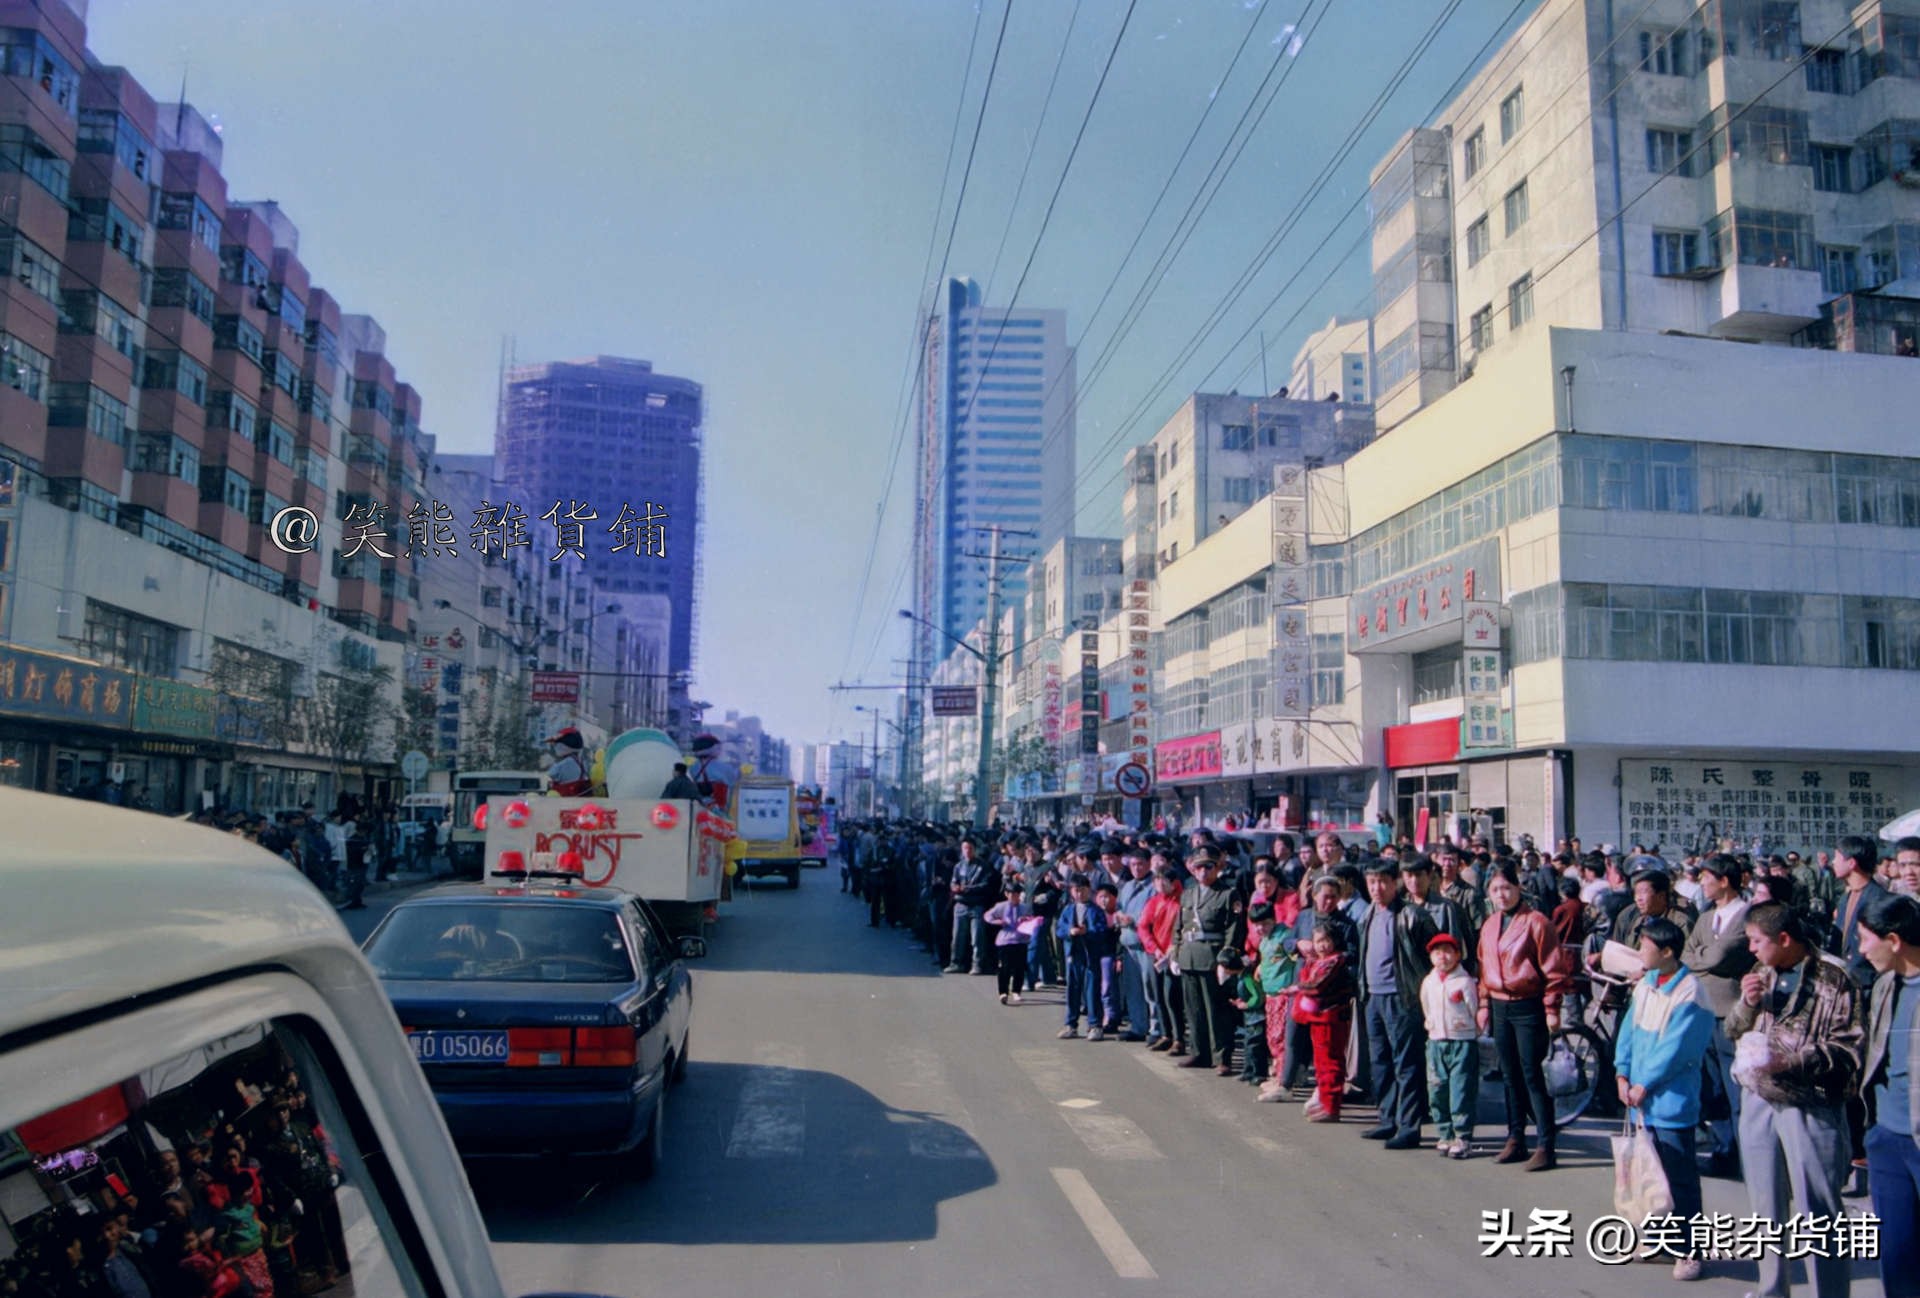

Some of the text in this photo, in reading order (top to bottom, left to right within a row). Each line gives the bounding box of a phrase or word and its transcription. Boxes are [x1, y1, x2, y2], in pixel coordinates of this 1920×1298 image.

[1651, 766, 1872, 787] 陈氏整骨院
[535, 832, 643, 887] ROBUST
[442, 1035, 506, 1057] 05066
